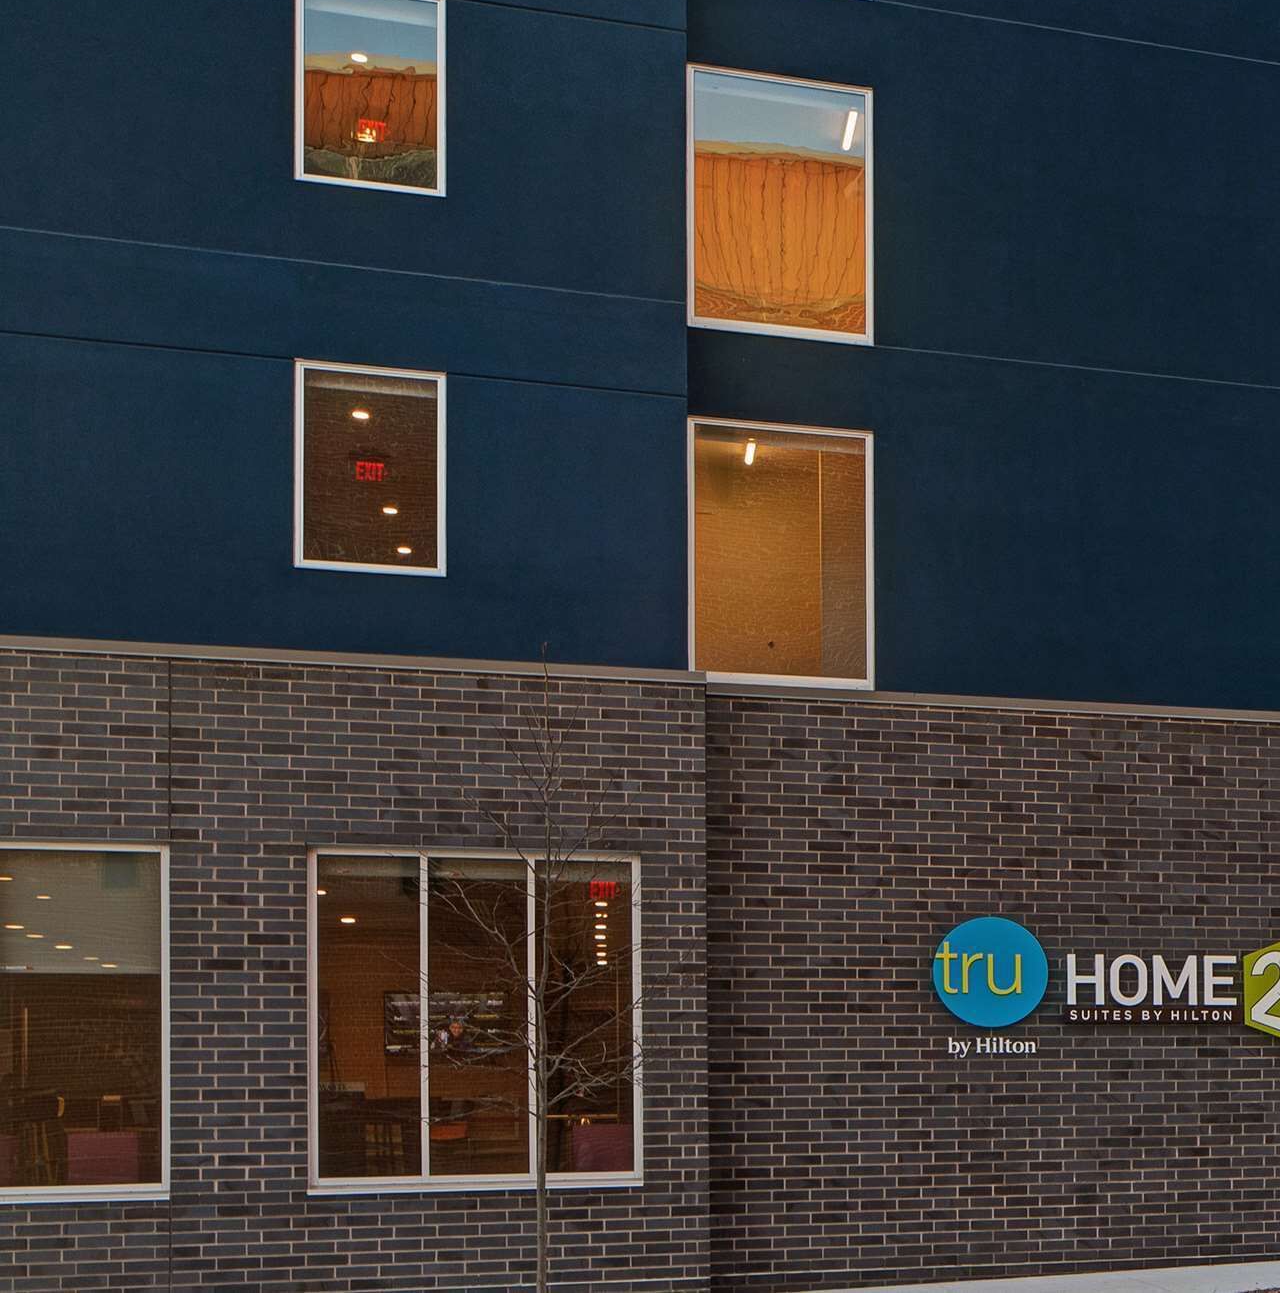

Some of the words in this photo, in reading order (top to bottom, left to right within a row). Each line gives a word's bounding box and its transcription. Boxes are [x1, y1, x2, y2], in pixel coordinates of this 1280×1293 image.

[355, 460, 385, 482] EXIT
[590, 880, 616, 899] EXIT
[935, 940, 1023, 996] tru
[1066, 953, 1238, 1007] HOME
[1069, 1010, 1133, 1021] SUITES
[1142, 1010, 1163, 1021] BY
[1171, 1010, 1234, 1021] HILTON
[947, 1037, 971, 1058] by
[975, 1037, 1038, 1055] Hilton
